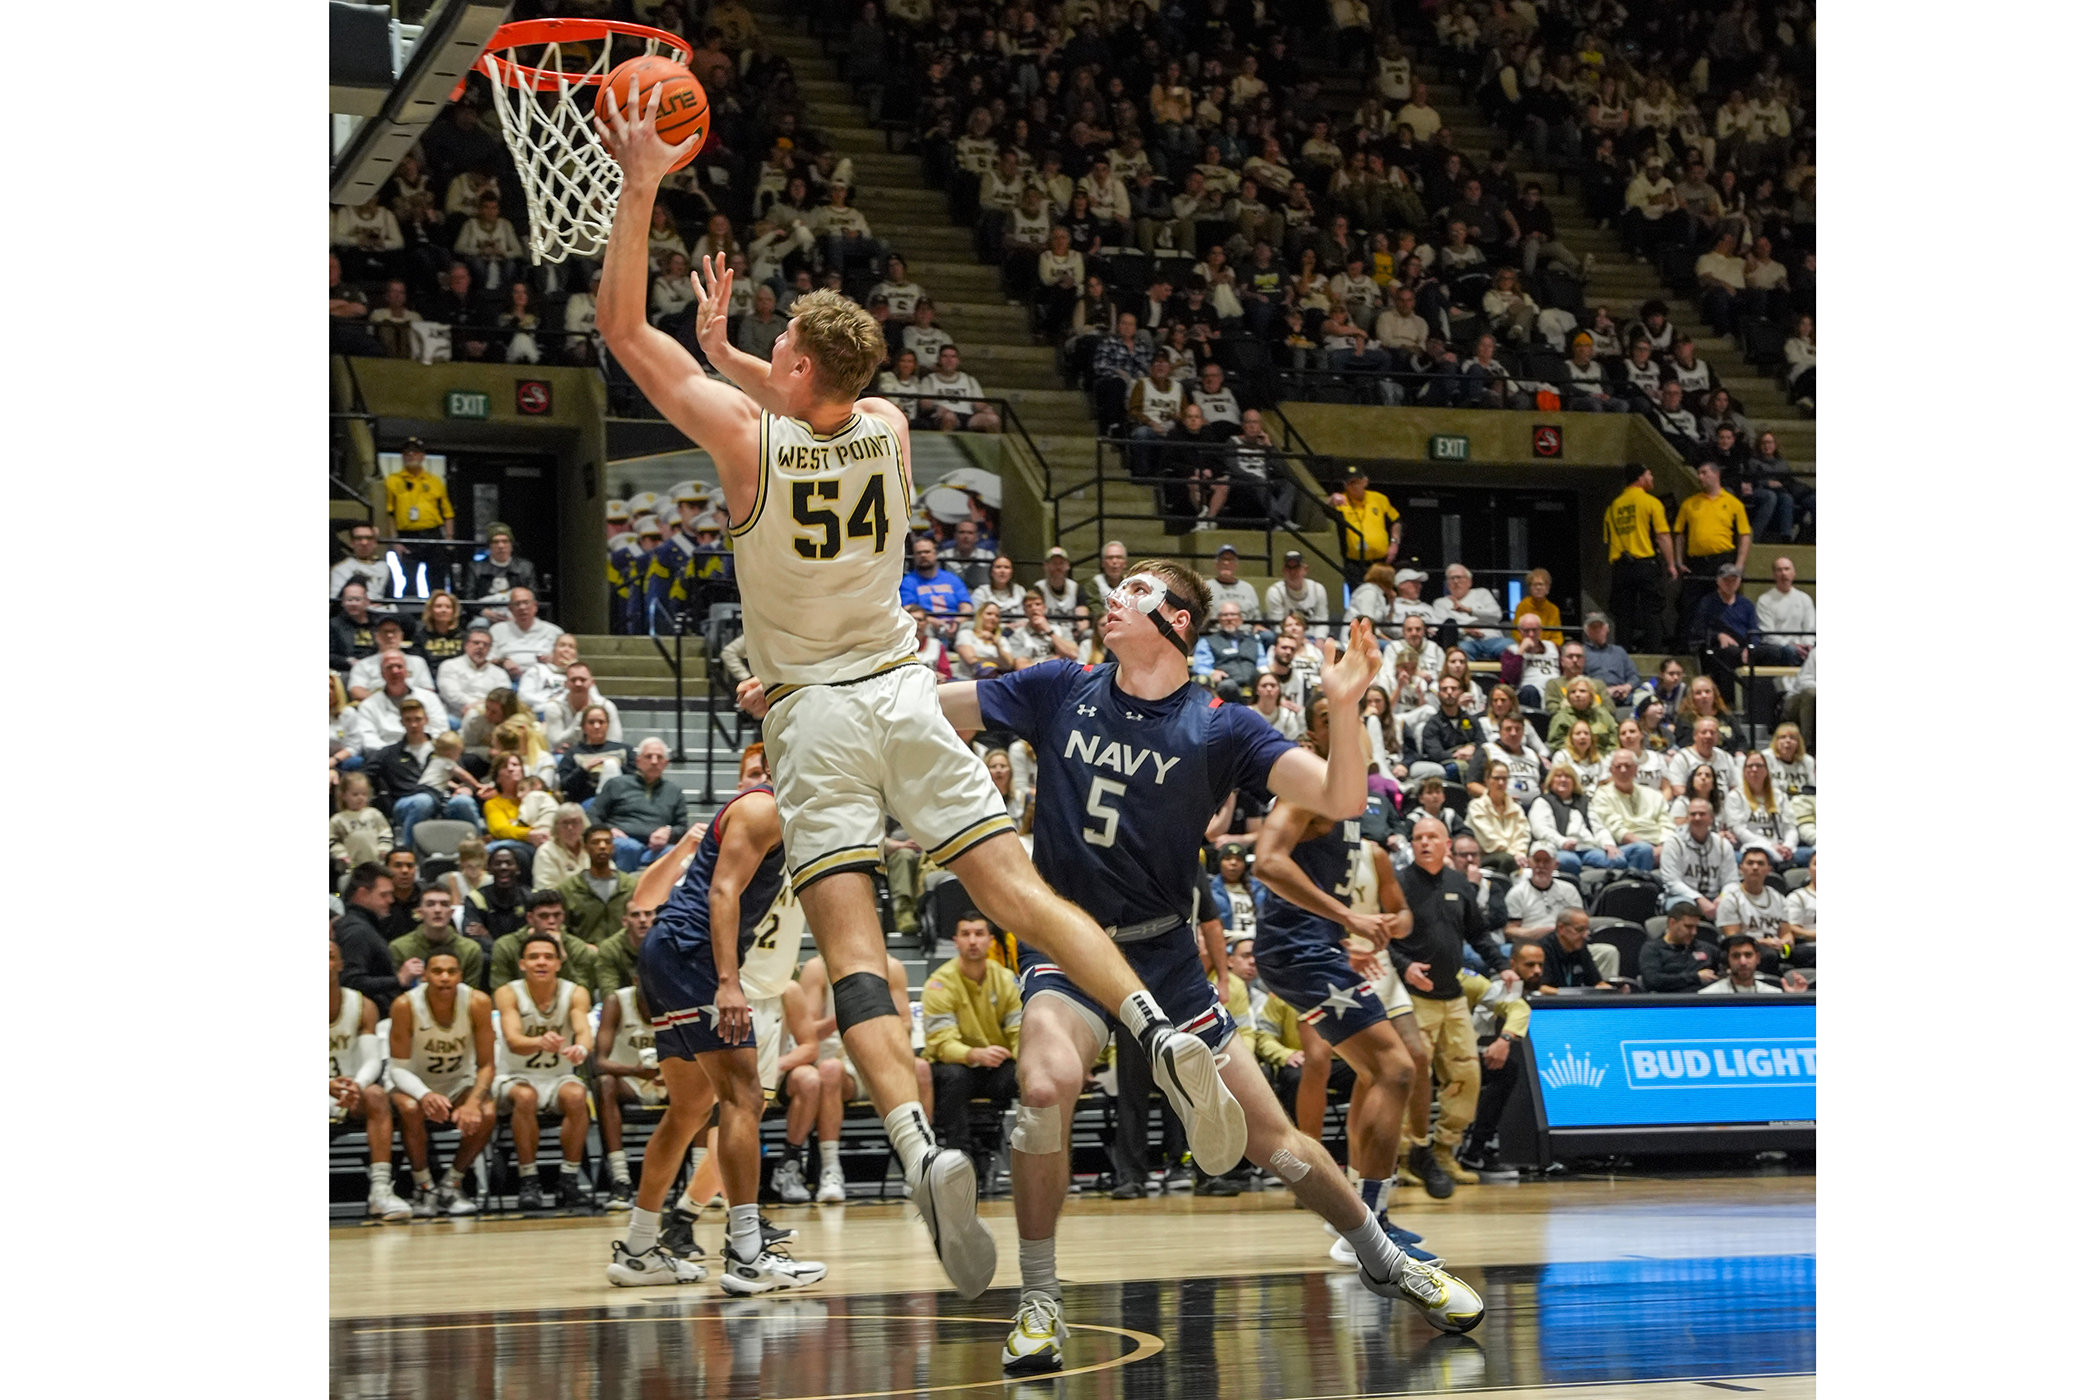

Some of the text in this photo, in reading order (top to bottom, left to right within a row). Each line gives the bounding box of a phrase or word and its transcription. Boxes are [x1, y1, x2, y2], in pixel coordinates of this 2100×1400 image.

[644, 90, 698, 120] LITE
[451, 394, 487, 416] EXIT
[778, 435, 891, 471] WEST POINT
[1436, 437, 1466, 457] EXIT
[789, 472, 890, 560] 54
[1063, 729, 1182, 786] NAVY
[1082, 775, 1128, 849] 5
[424, 1036, 467, 1054] ARMY
[1632, 1048, 1816, 1079] BUD LIGHT
